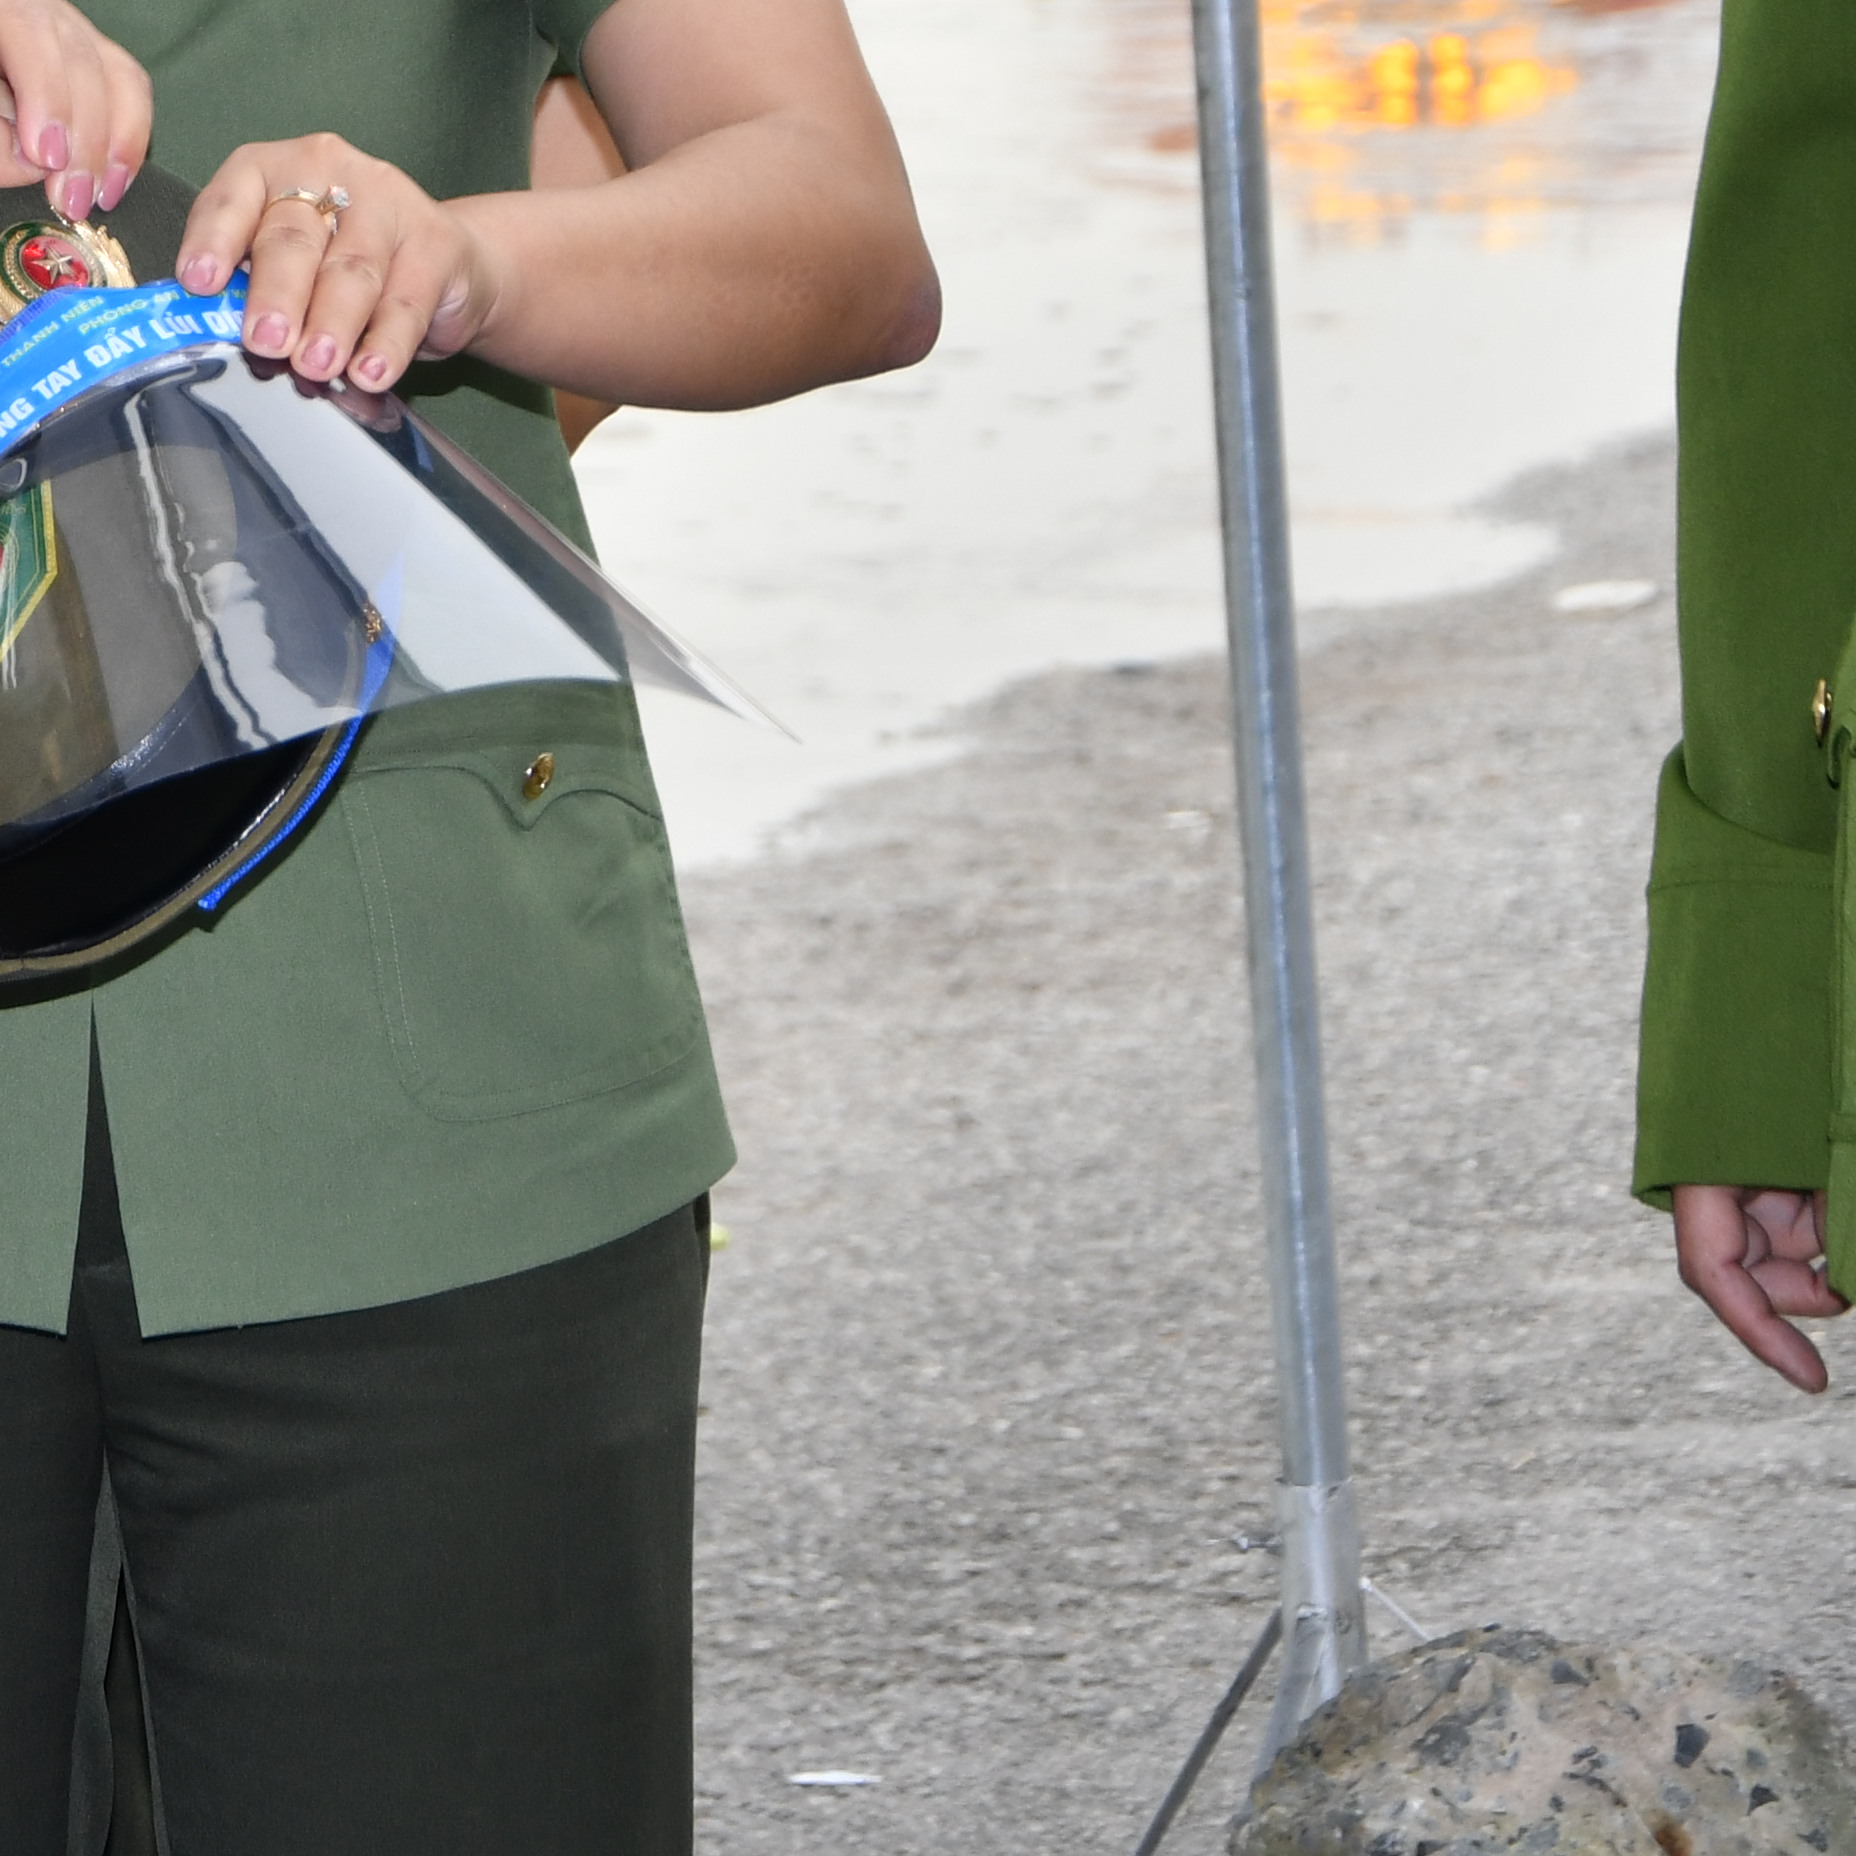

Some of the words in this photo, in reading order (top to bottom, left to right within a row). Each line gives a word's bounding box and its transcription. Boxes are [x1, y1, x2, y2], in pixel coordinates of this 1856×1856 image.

[1, 321, 60, 367] THANH
[31, 358, 83, 400] TAY
[83, 326, 147, 369] ĐẨY
[201, 310, 244, 338] DỊ
